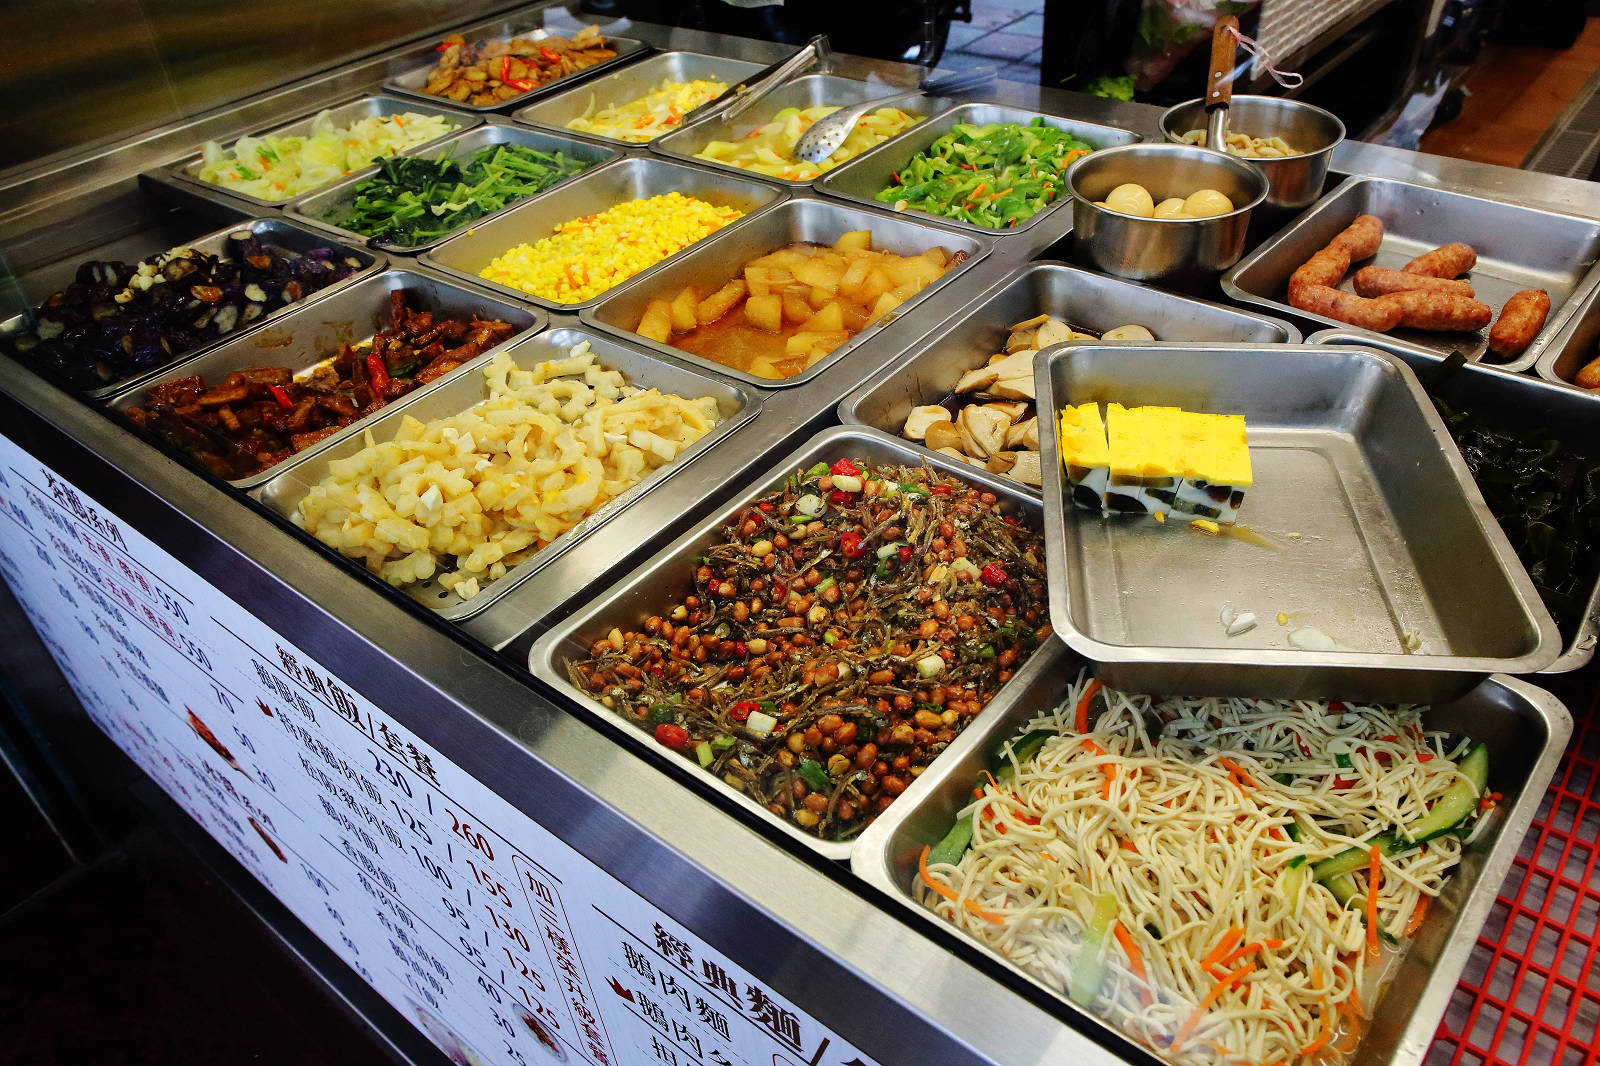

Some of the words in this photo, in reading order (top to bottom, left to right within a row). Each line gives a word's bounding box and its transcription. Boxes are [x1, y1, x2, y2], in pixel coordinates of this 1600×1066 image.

[154, 586, 189, 625] 550
[179, 633, 212, 671] 550
[210, 684, 235, 714] 70
[233, 726, 256, 754] 50
[275, 642, 441, 787] 經典飯/套餐
[251, 659, 320, 728] 鵝腿飯
[367, 748, 412, 798] 230
[444, 808, 494, 861] 260
[252, 764, 276, 792] 30
[275, 707, 388, 811] 特盛鵝肉飯
[390, 800, 432, 845] 125
[465, 859, 512, 908] 155
[317, 795, 383, 859] 鵝肉飯
[442, 897, 470, 930] 95
[502, 946, 545, 992] 125
[411, 845, 452, 890] 100
[485, 905, 530, 952] 130
[459, 936, 486, 968] 95
[518, 986, 560, 1029] 125
[478, 976, 501, 1004] 40
[524, 871, 611, 1066] 加三樣菜升級套餐
[621, 941, 732, 1042] 鵝肉麵
[653, 922, 872, 1066] 經典麵/
[489, 1007, 515, 1038] 30
[503, 1040, 526, 1066] 25
